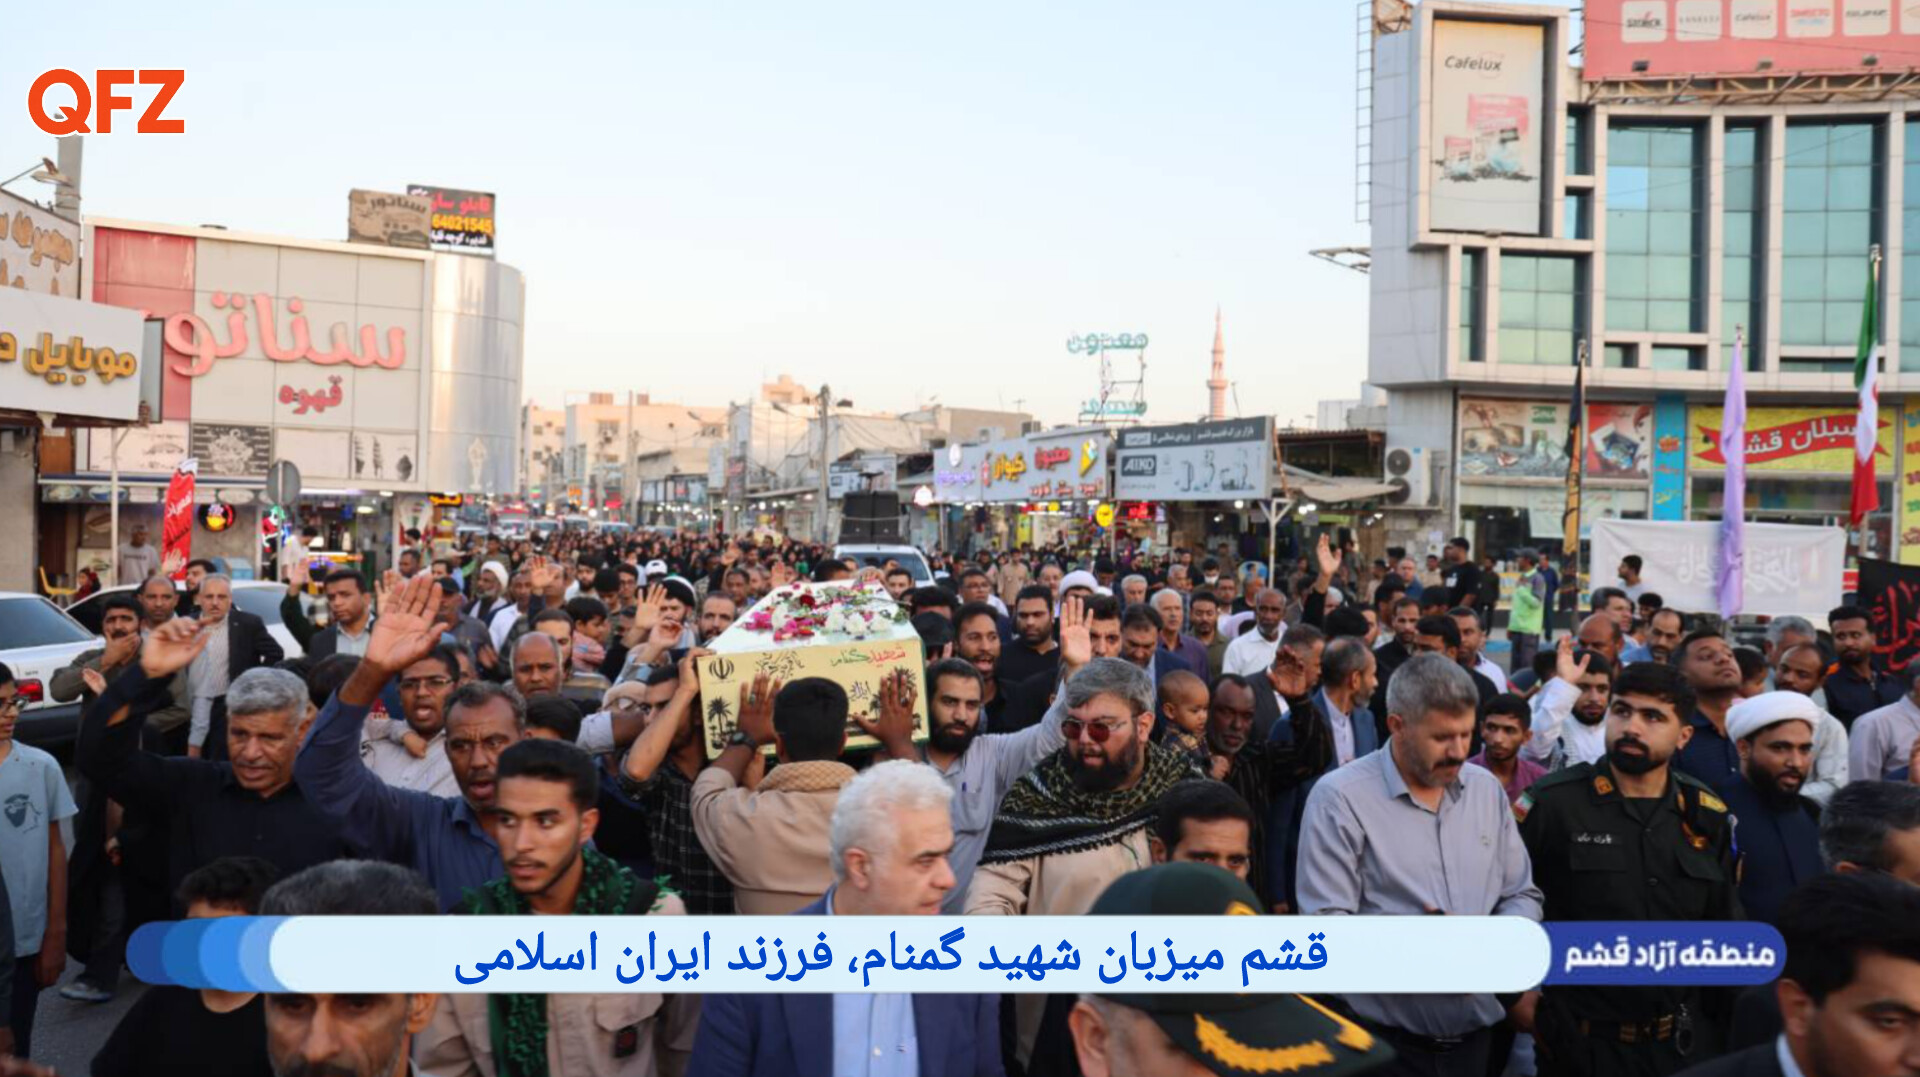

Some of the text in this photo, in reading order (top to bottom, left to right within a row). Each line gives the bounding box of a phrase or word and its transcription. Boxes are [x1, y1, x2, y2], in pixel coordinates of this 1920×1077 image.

[1444, 55, 1502, 72] Cafelux
[163, 289, 406, 377] سناتو
[23, 331, 137, 385] موبایل
[279, 374, 343, 415] قهوه
[1746, 430, 1783, 455] قش
[1123, 457, 1155, 472] AIKO
